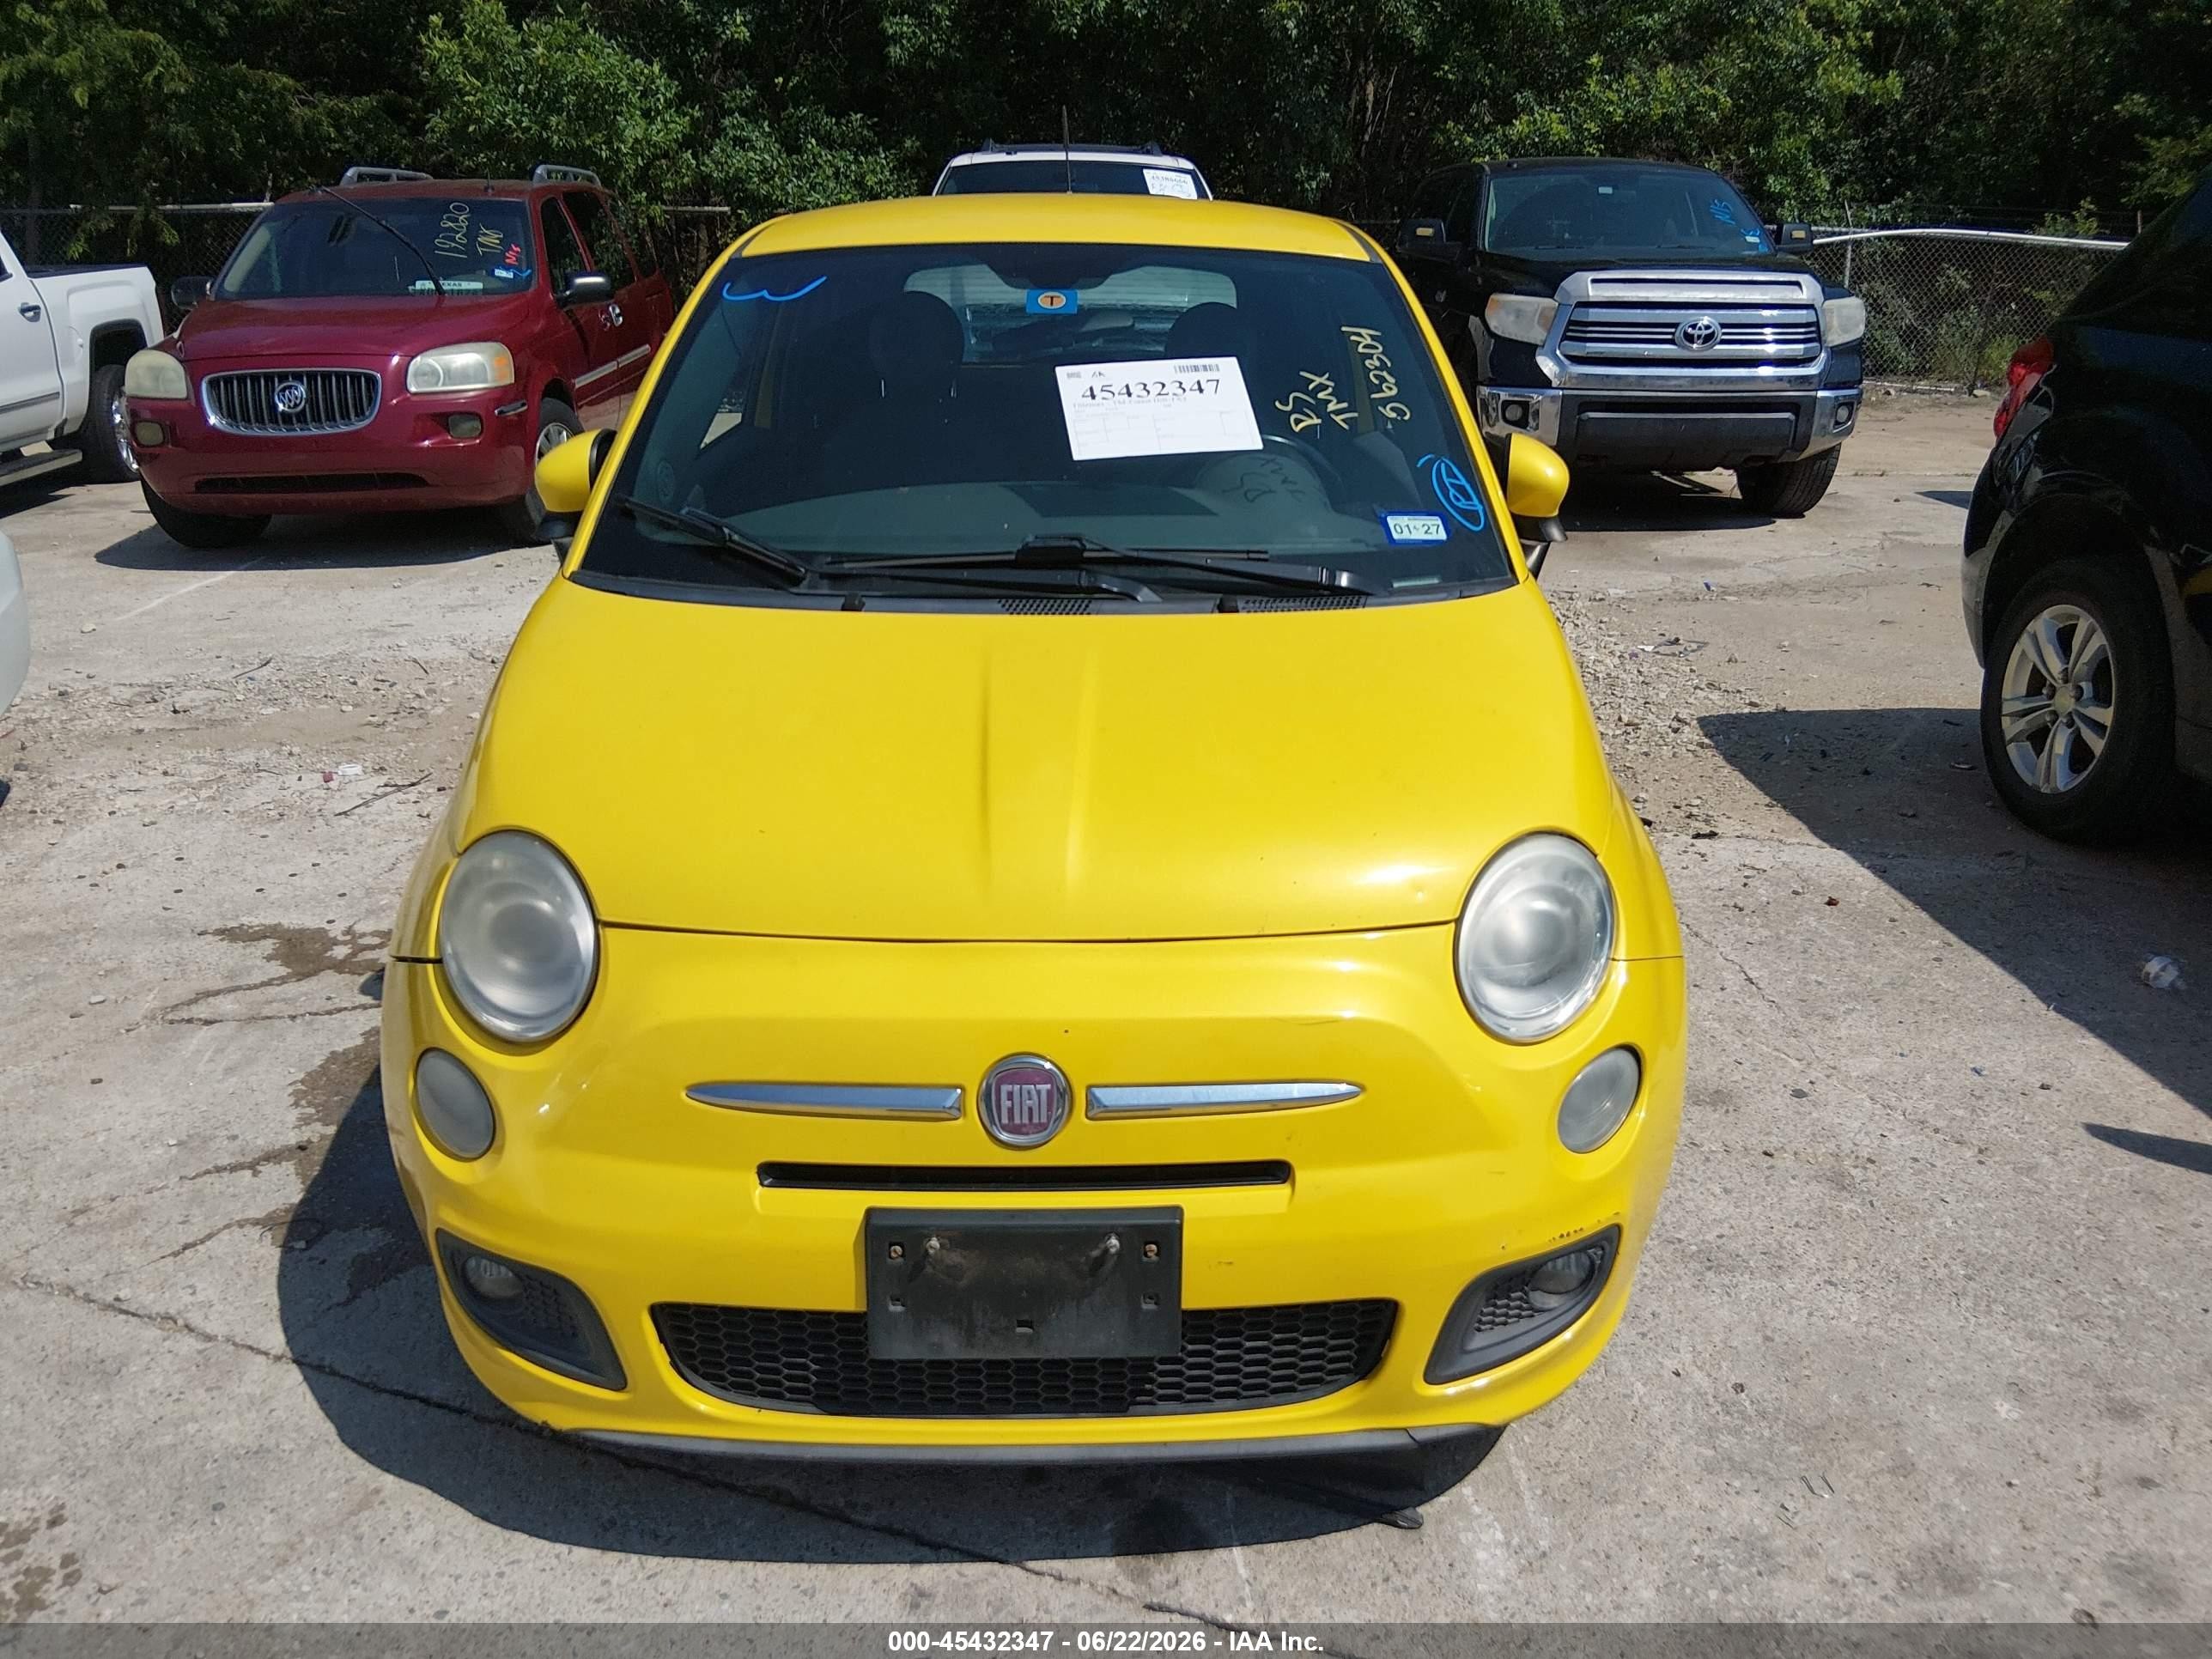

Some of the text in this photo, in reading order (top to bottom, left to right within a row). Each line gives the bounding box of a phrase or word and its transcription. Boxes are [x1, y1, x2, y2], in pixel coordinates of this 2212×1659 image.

[1081, 378, 1220, 401] 45432347
[1340, 325, 1412, 421] 562304
[1298, 370, 1359, 430] TMX
[1393, 522, 1440, 535] 01 27
[1000, 1084, 1052, 1124] FIAT
